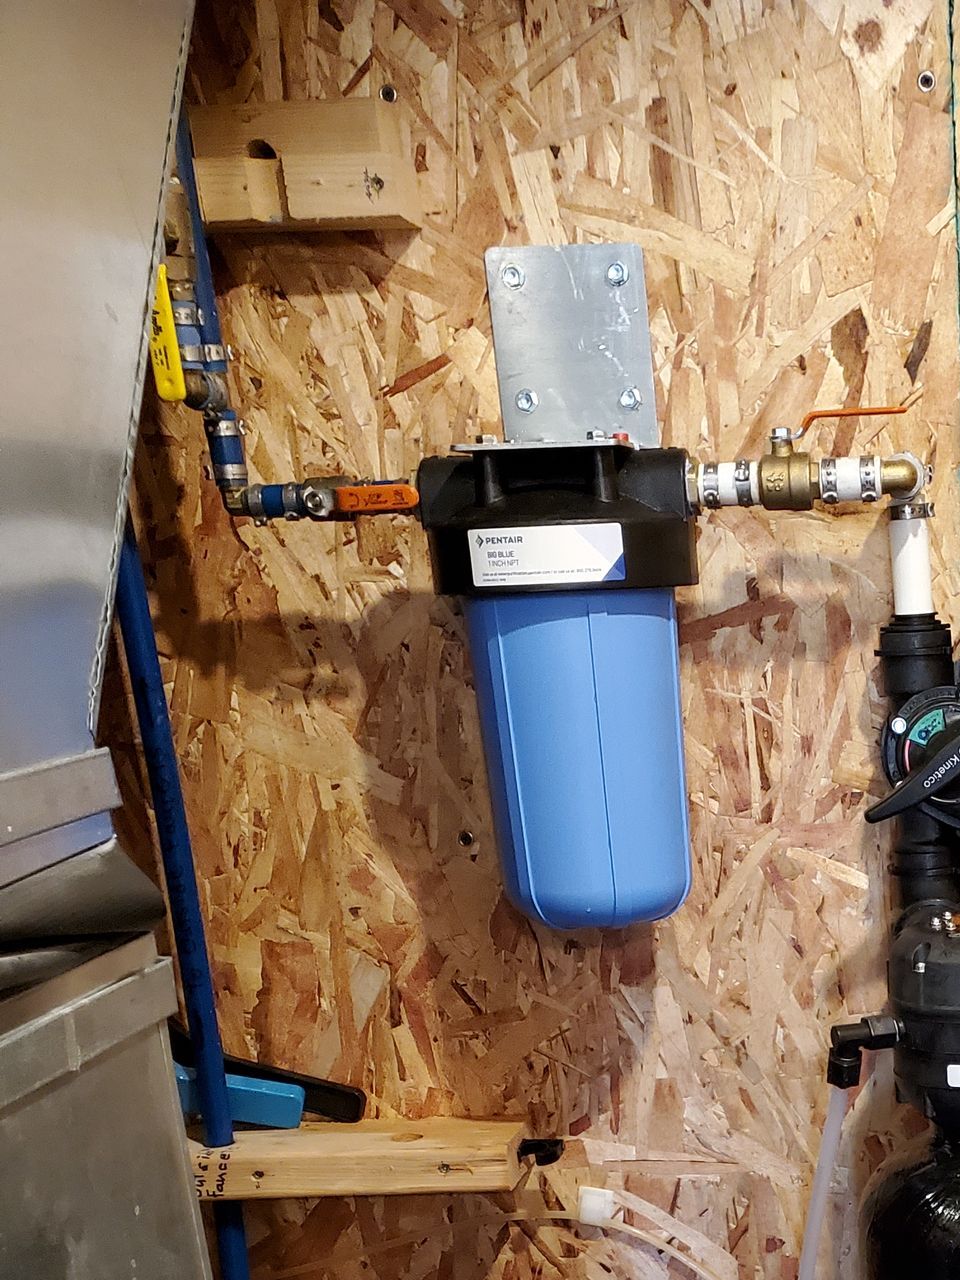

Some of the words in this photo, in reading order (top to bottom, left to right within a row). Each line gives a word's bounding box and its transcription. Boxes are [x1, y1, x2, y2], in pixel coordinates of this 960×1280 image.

[485, 535, 523, 545] PENTAIR
[498, 550, 515, 558] BLUE
[923, 755, 960, 789] Kinetico
